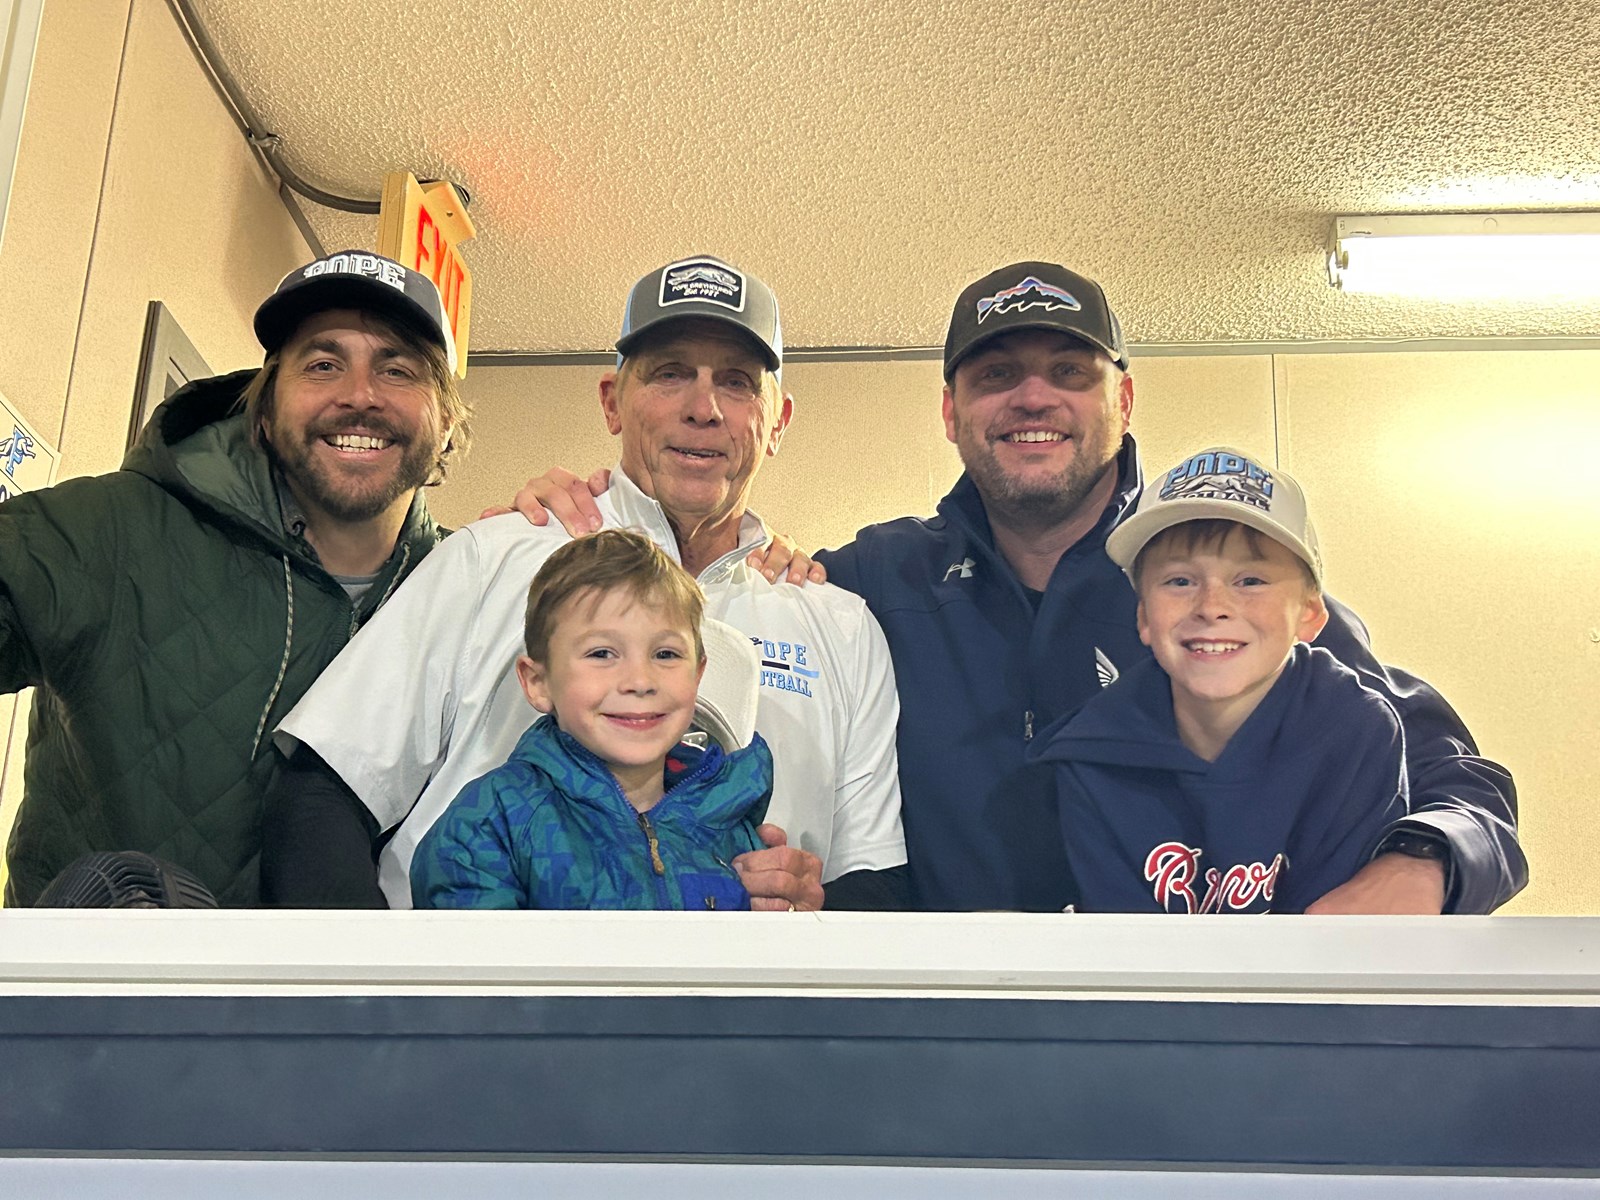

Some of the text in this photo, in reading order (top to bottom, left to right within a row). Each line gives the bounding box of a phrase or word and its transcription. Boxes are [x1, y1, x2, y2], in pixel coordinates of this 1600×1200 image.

[303, 254, 406, 293] POPE
[1159, 451, 1273, 499] POPE
[763, 640, 807, 666] OPE
